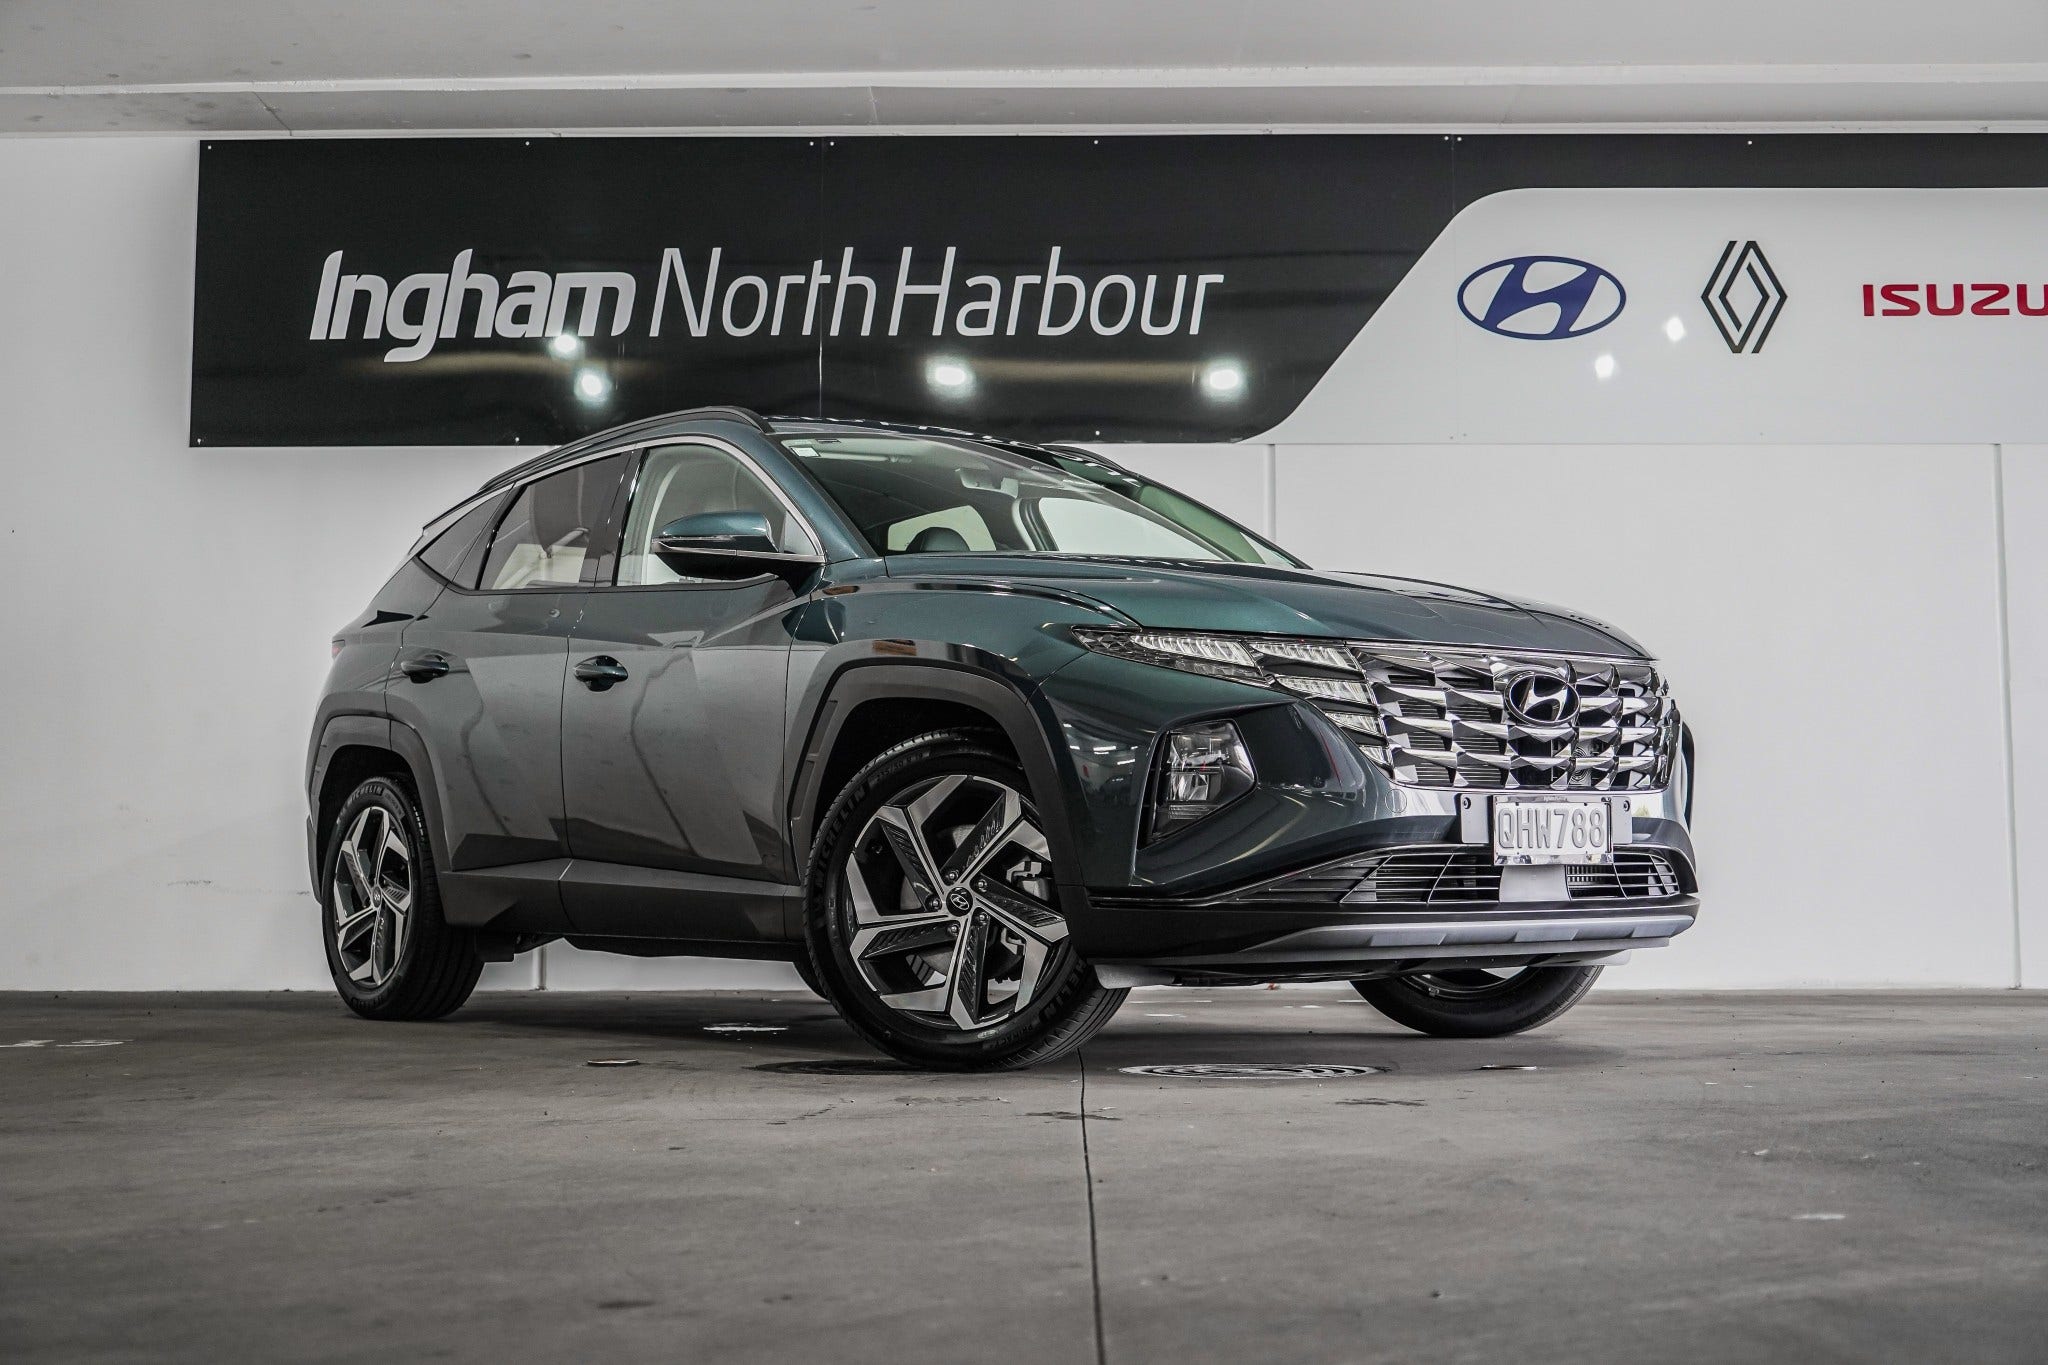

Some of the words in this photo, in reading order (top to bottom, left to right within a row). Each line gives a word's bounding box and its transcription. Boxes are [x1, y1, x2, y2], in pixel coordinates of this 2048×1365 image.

[309, 249, 637, 363] Ingham
[649, 247, 877, 338] North
[888, 246, 1225, 337] Harbour
[1862, 283, 2048, 317] ISUZU
[1498, 808, 1605, 849] QHW788
